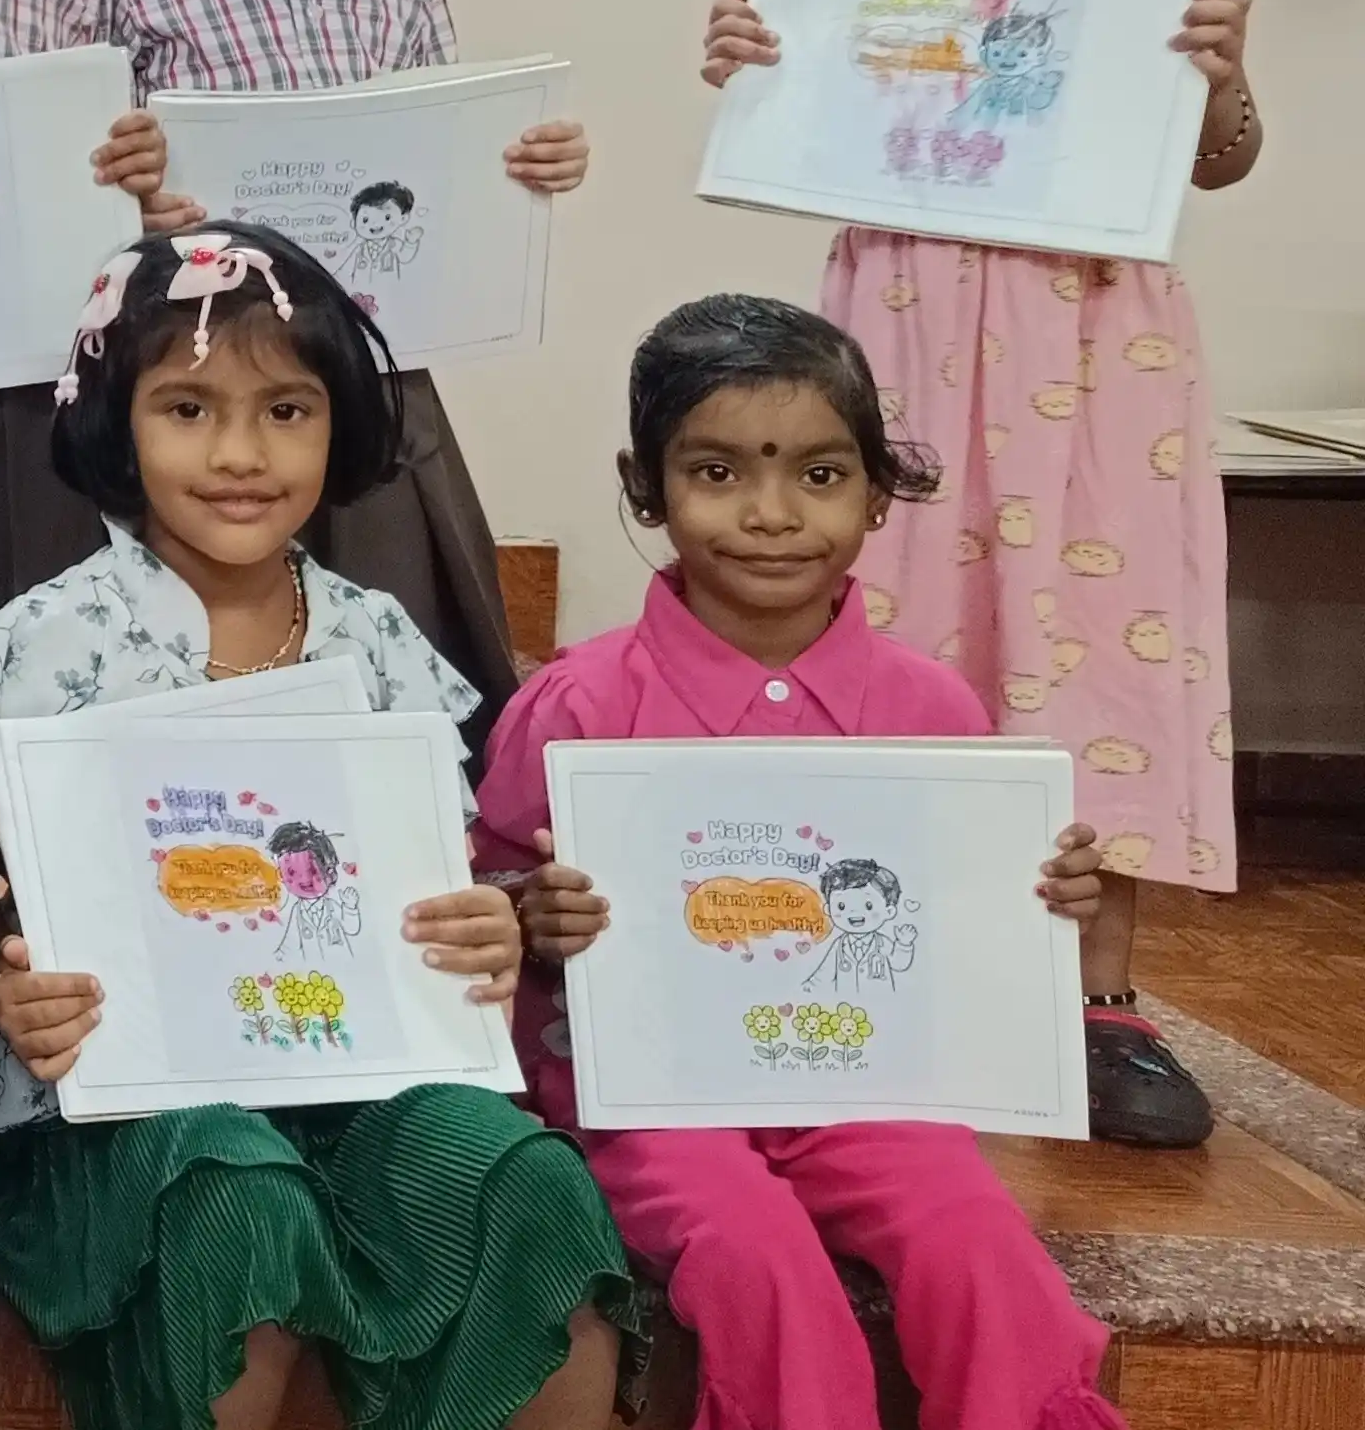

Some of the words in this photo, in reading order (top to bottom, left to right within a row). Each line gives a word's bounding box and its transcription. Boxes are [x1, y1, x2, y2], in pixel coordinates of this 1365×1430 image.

[261, 159, 324, 179] Happy
[235, 180, 311, 199] Doctor's
[313, 180, 354, 199] Day!
[162, 783, 226, 811] Happy
[145, 816, 221, 839] Doctor's
[222, 813, 264, 839] Day!
[707, 820, 783, 844] Happy
[680, 846, 769, 869] Doctor's
[771, 847, 821, 874] Day!
[705, 890, 749, 907] Thank
[751, 893, 779, 909] you
[781, 890, 806, 907] for
[748, 919, 766, 930] us
